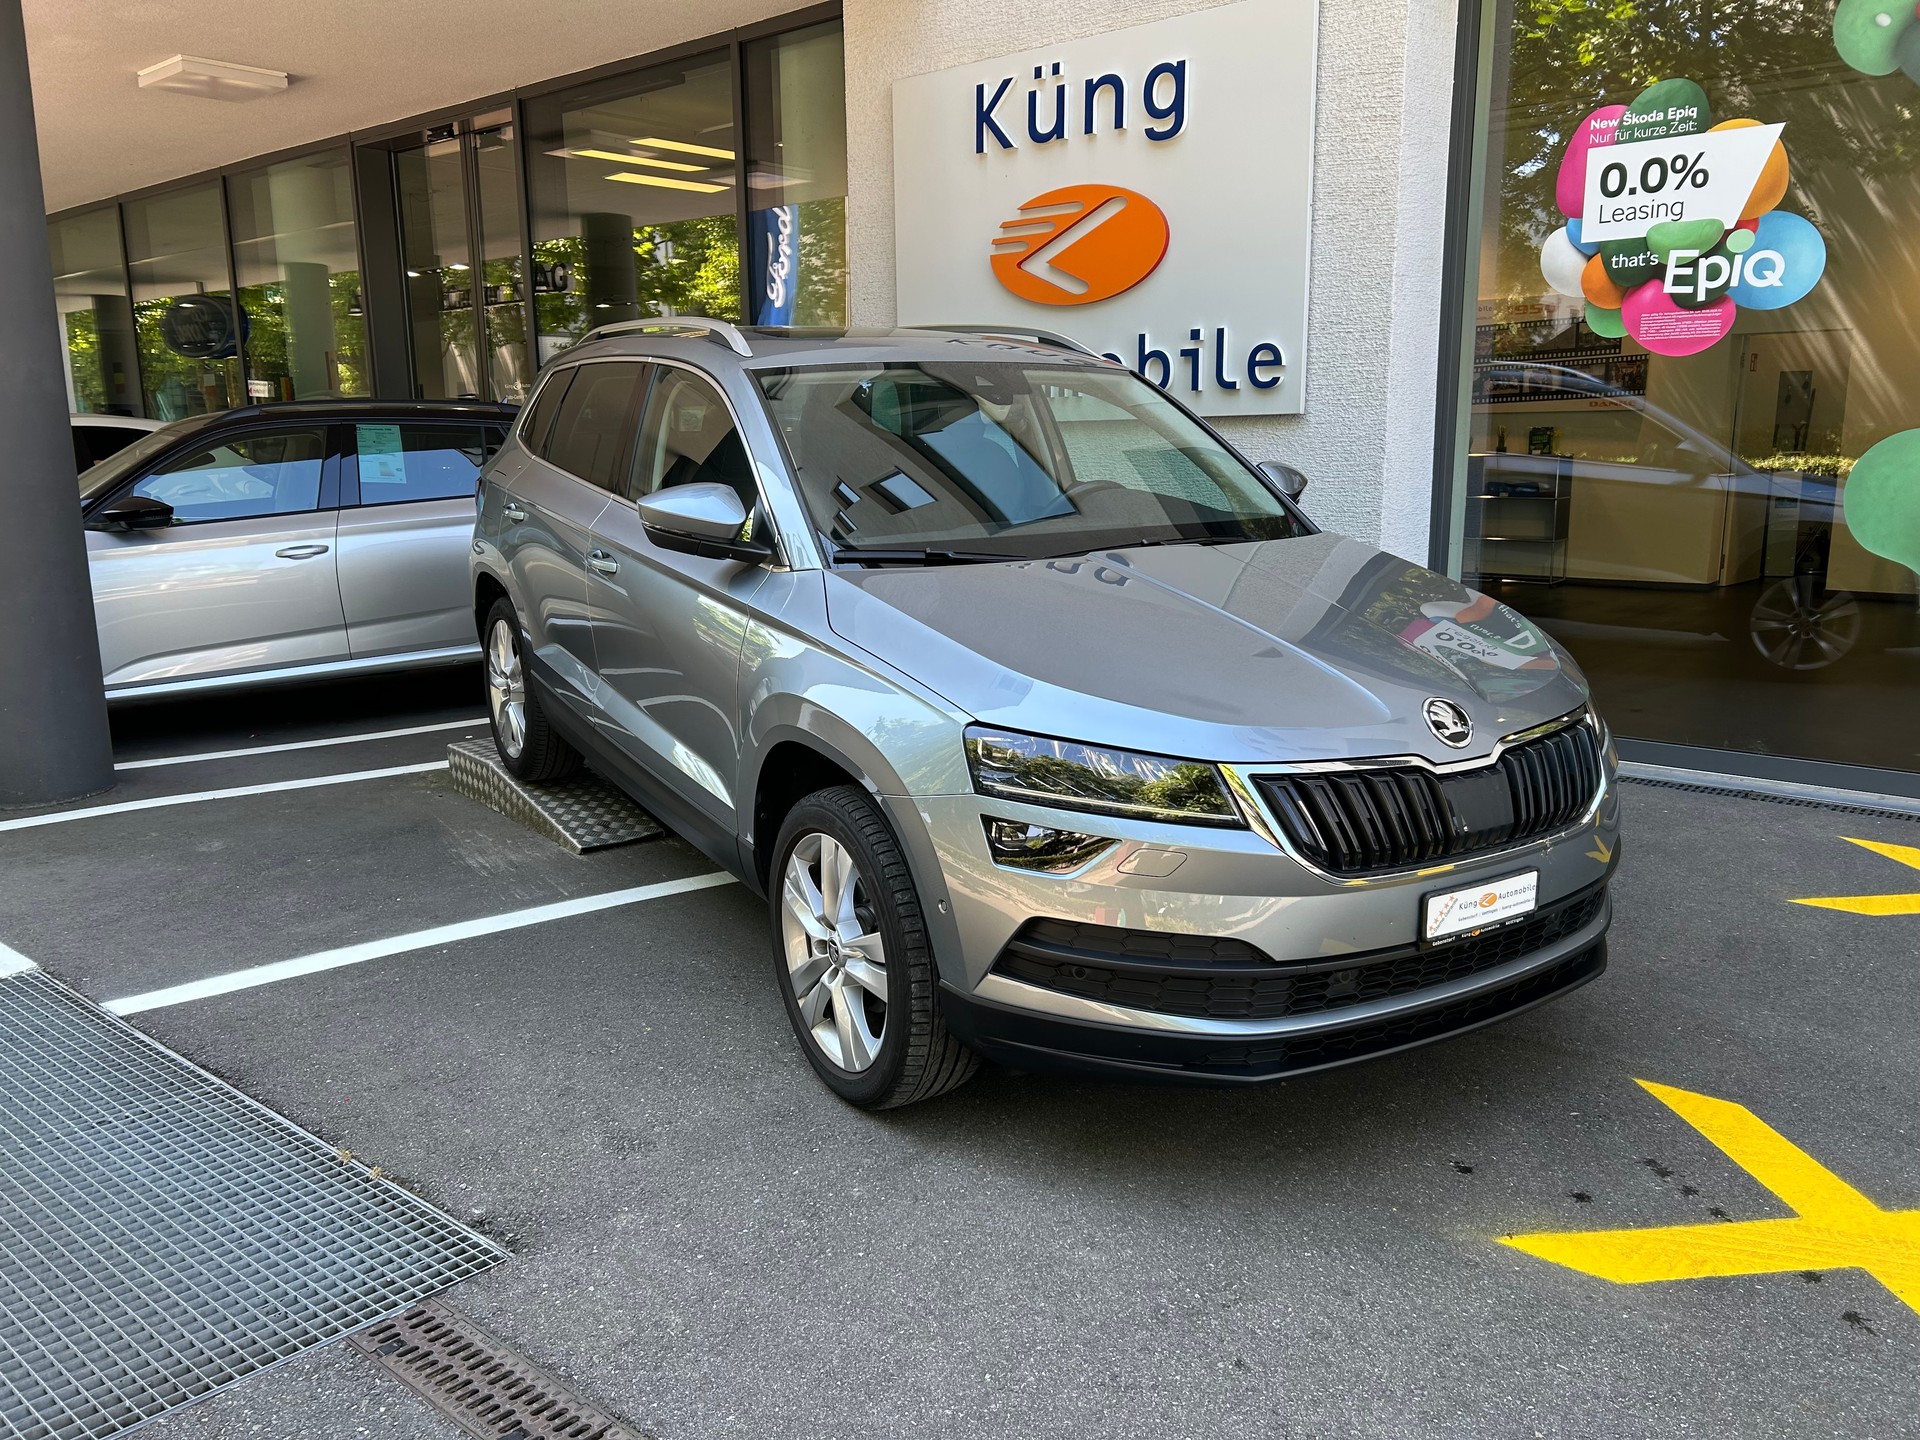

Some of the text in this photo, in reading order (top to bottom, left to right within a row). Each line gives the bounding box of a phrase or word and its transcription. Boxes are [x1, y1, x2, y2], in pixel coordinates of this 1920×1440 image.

[976, 59, 1188, 154] Küng
[1590, 105, 1698, 131] New Škoda Epiq
[1589, 120, 1698, 144] Nur für kurze Zeit:
[1600, 151, 1710, 199] 0.0%
[1599, 199, 1685, 224] Leasing
[767, 205, 793, 308] Ford
[1459, 883, 1536, 911] Küng Automobile
